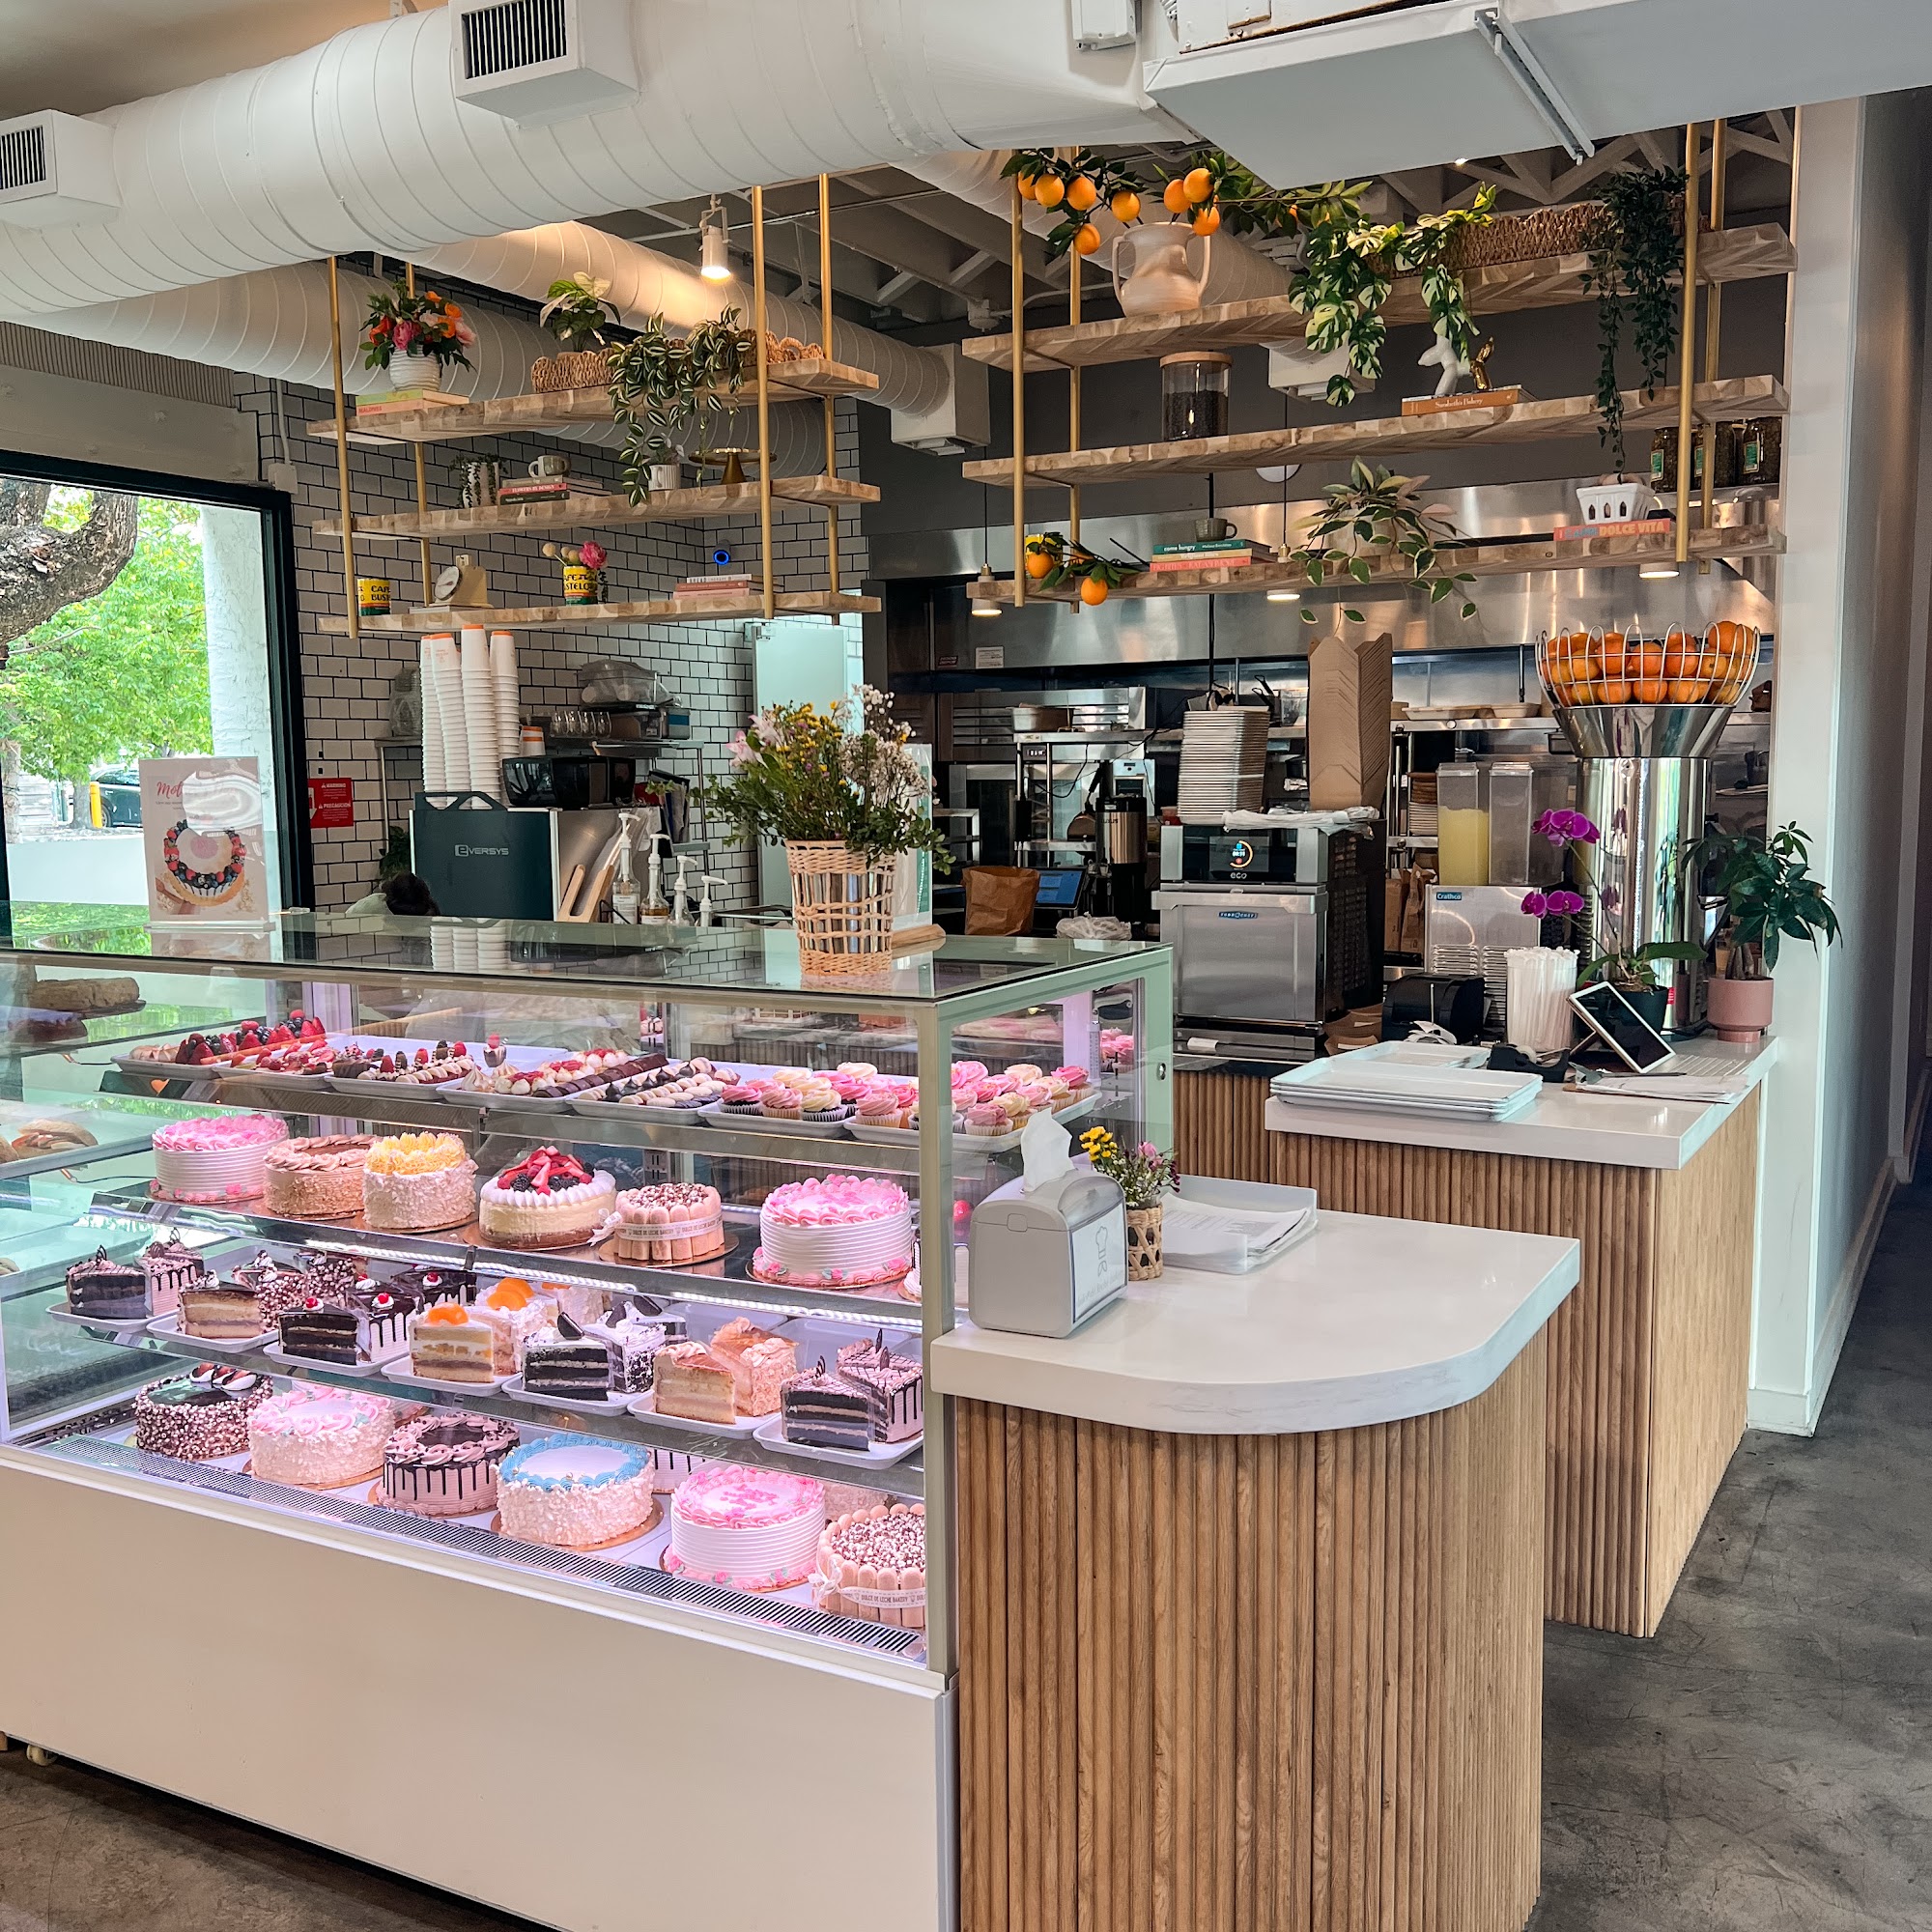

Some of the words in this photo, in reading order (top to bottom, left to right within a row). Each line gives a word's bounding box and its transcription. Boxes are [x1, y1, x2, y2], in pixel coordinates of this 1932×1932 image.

[1600, 524, 1635, 537] DOLCE
[1637, 521, 1664, 533] VITA
[1179, 543, 1196, 552] hungry
[454, 844, 509, 857] EVERSYS
